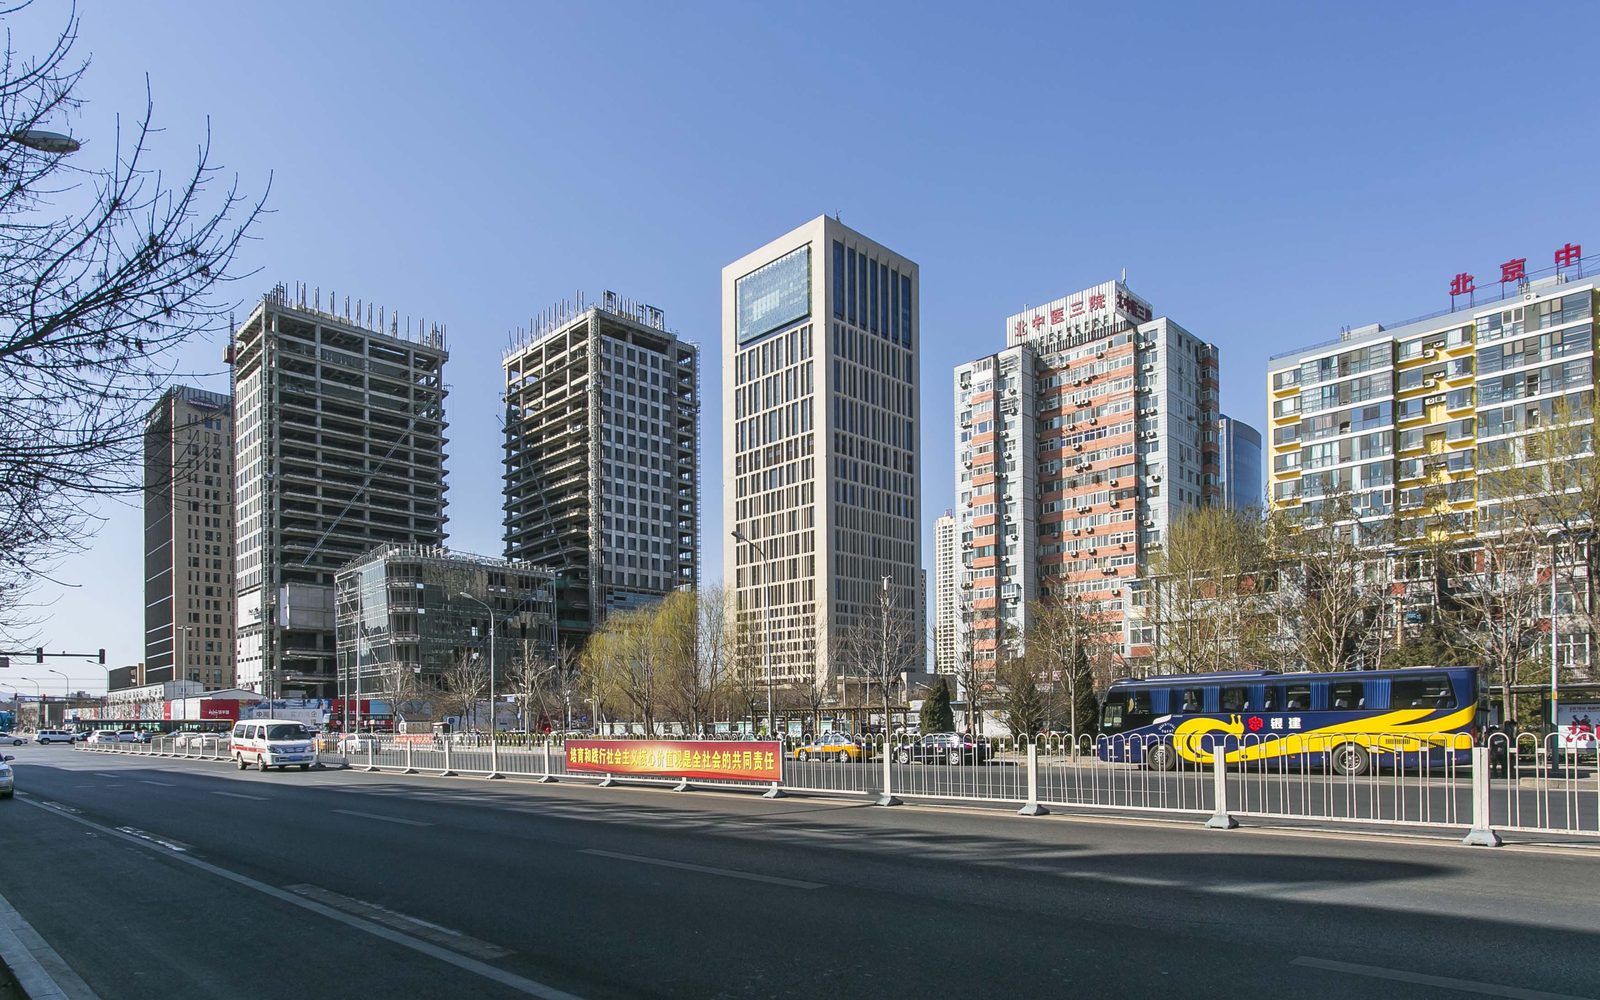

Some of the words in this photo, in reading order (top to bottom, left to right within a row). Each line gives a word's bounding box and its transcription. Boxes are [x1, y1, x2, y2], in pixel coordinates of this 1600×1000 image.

[1449, 243, 1582, 296] 北京中
[1015, 294, 1106, 337] 北中医三院
[1270, 717, 1302, 730] 银建
[569, 747, 775, 771] 培育和践行社会主义核心价值观是全社会的共同责任
